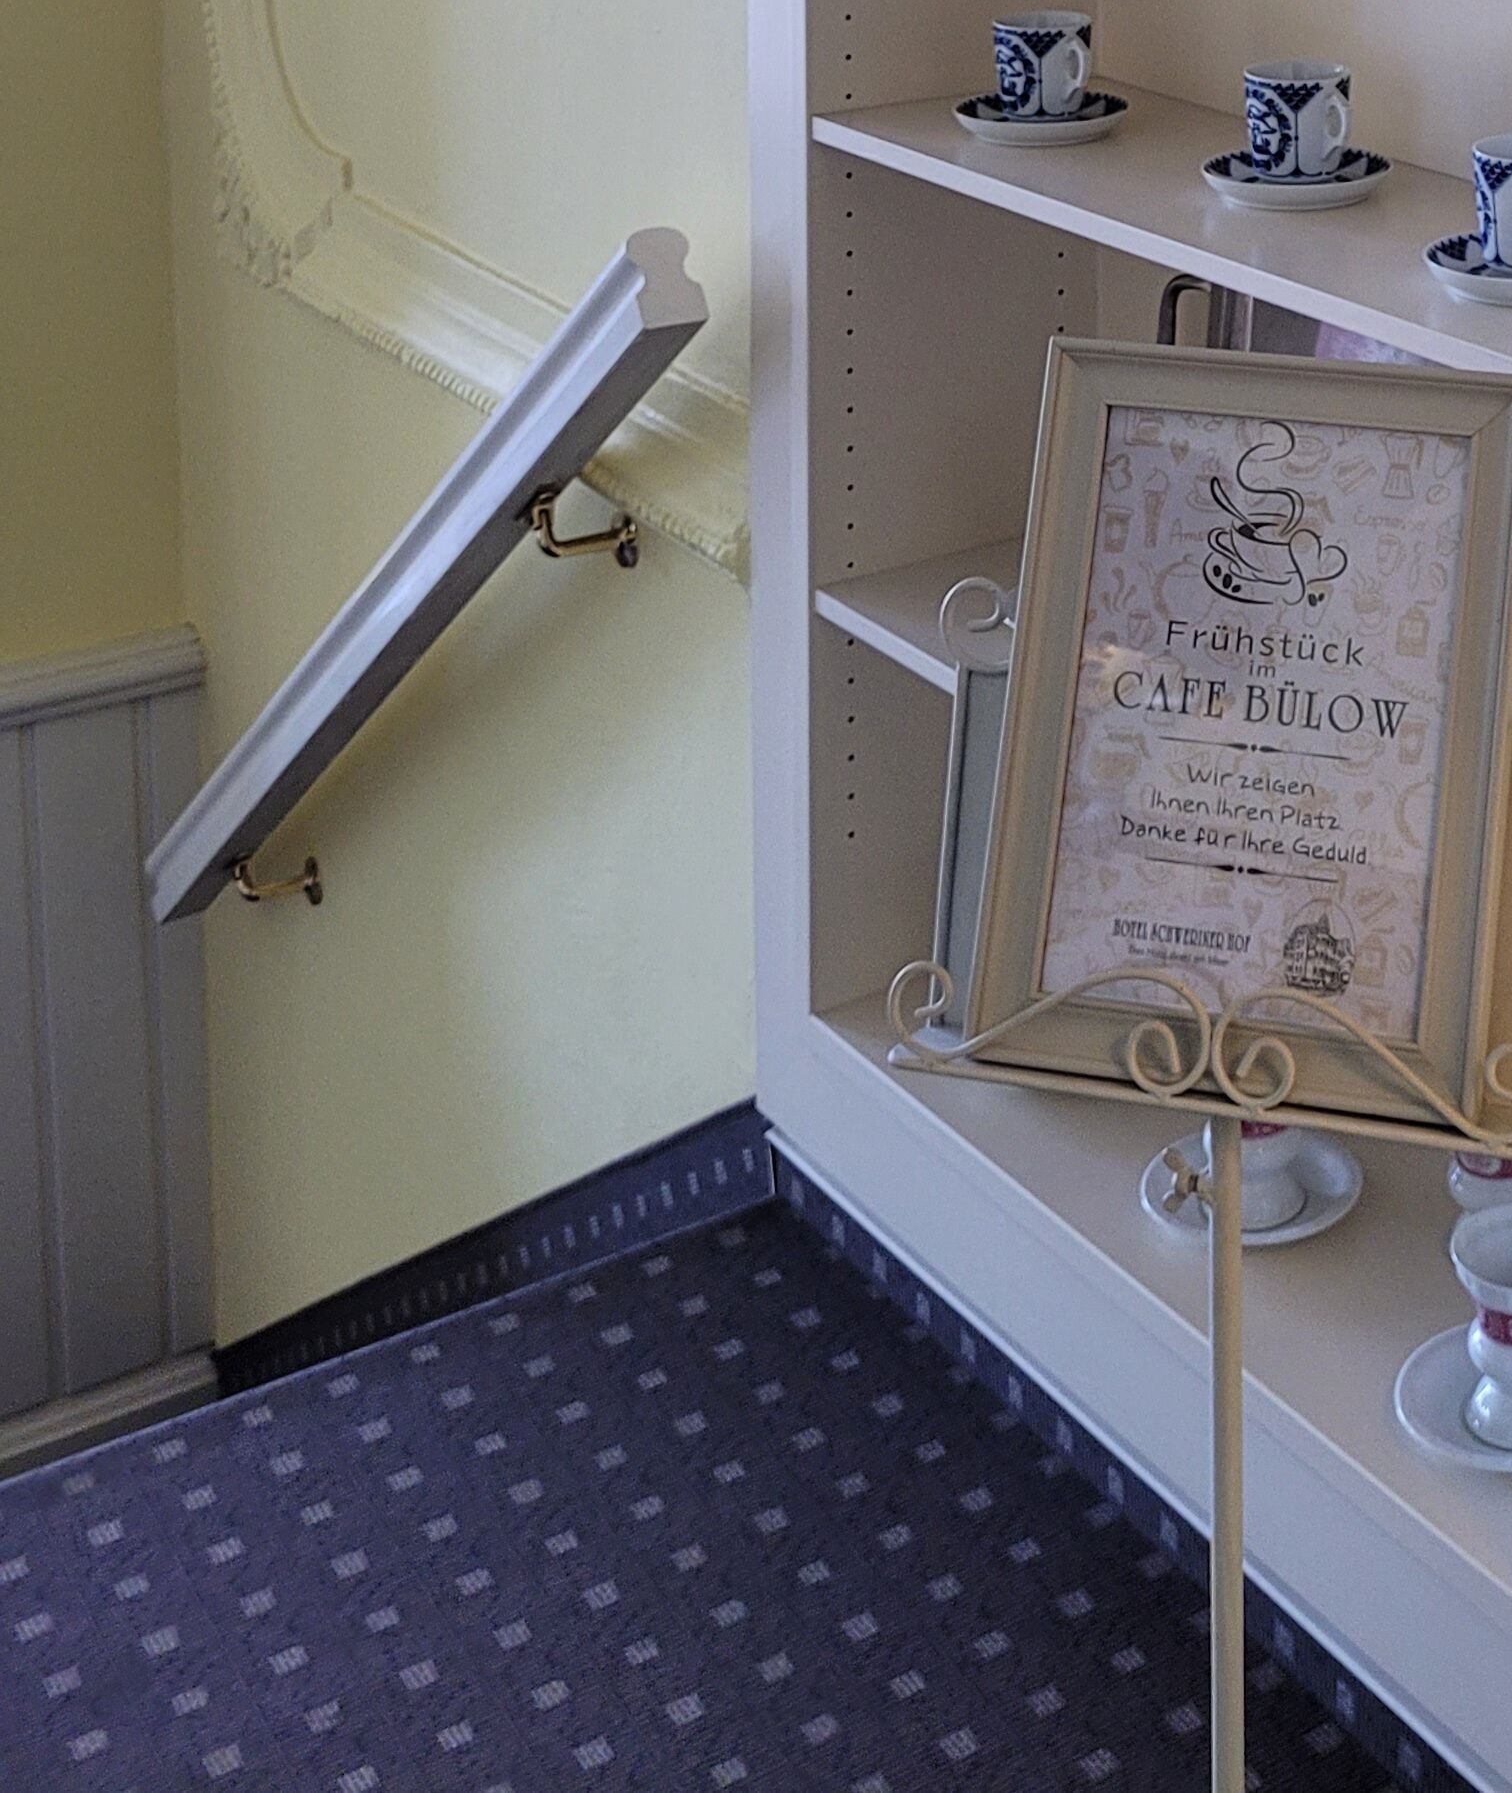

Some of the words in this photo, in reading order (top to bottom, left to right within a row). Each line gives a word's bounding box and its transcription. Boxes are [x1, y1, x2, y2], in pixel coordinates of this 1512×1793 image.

[1165, 619, 1365, 667] Frühstück
[1249, 660, 1276, 679] im
[1113, 670, 1227, 719] CAFE
[1243, 680, 1410, 739] BÜLOW
[1186, 762, 1233, 787] Wir
[1150, 787, 1210, 816] Ihnen
[1216, 796, 1274, 822] Ihren
[1120, 814, 1187, 843] Danke
[1241, 830, 1285, 855] Ihre
[1112, 918, 1148, 941] HOTEL
[1150, 922, 1226, 951] SCHWERINER
[1226, 933, 1252, 953] HOF
